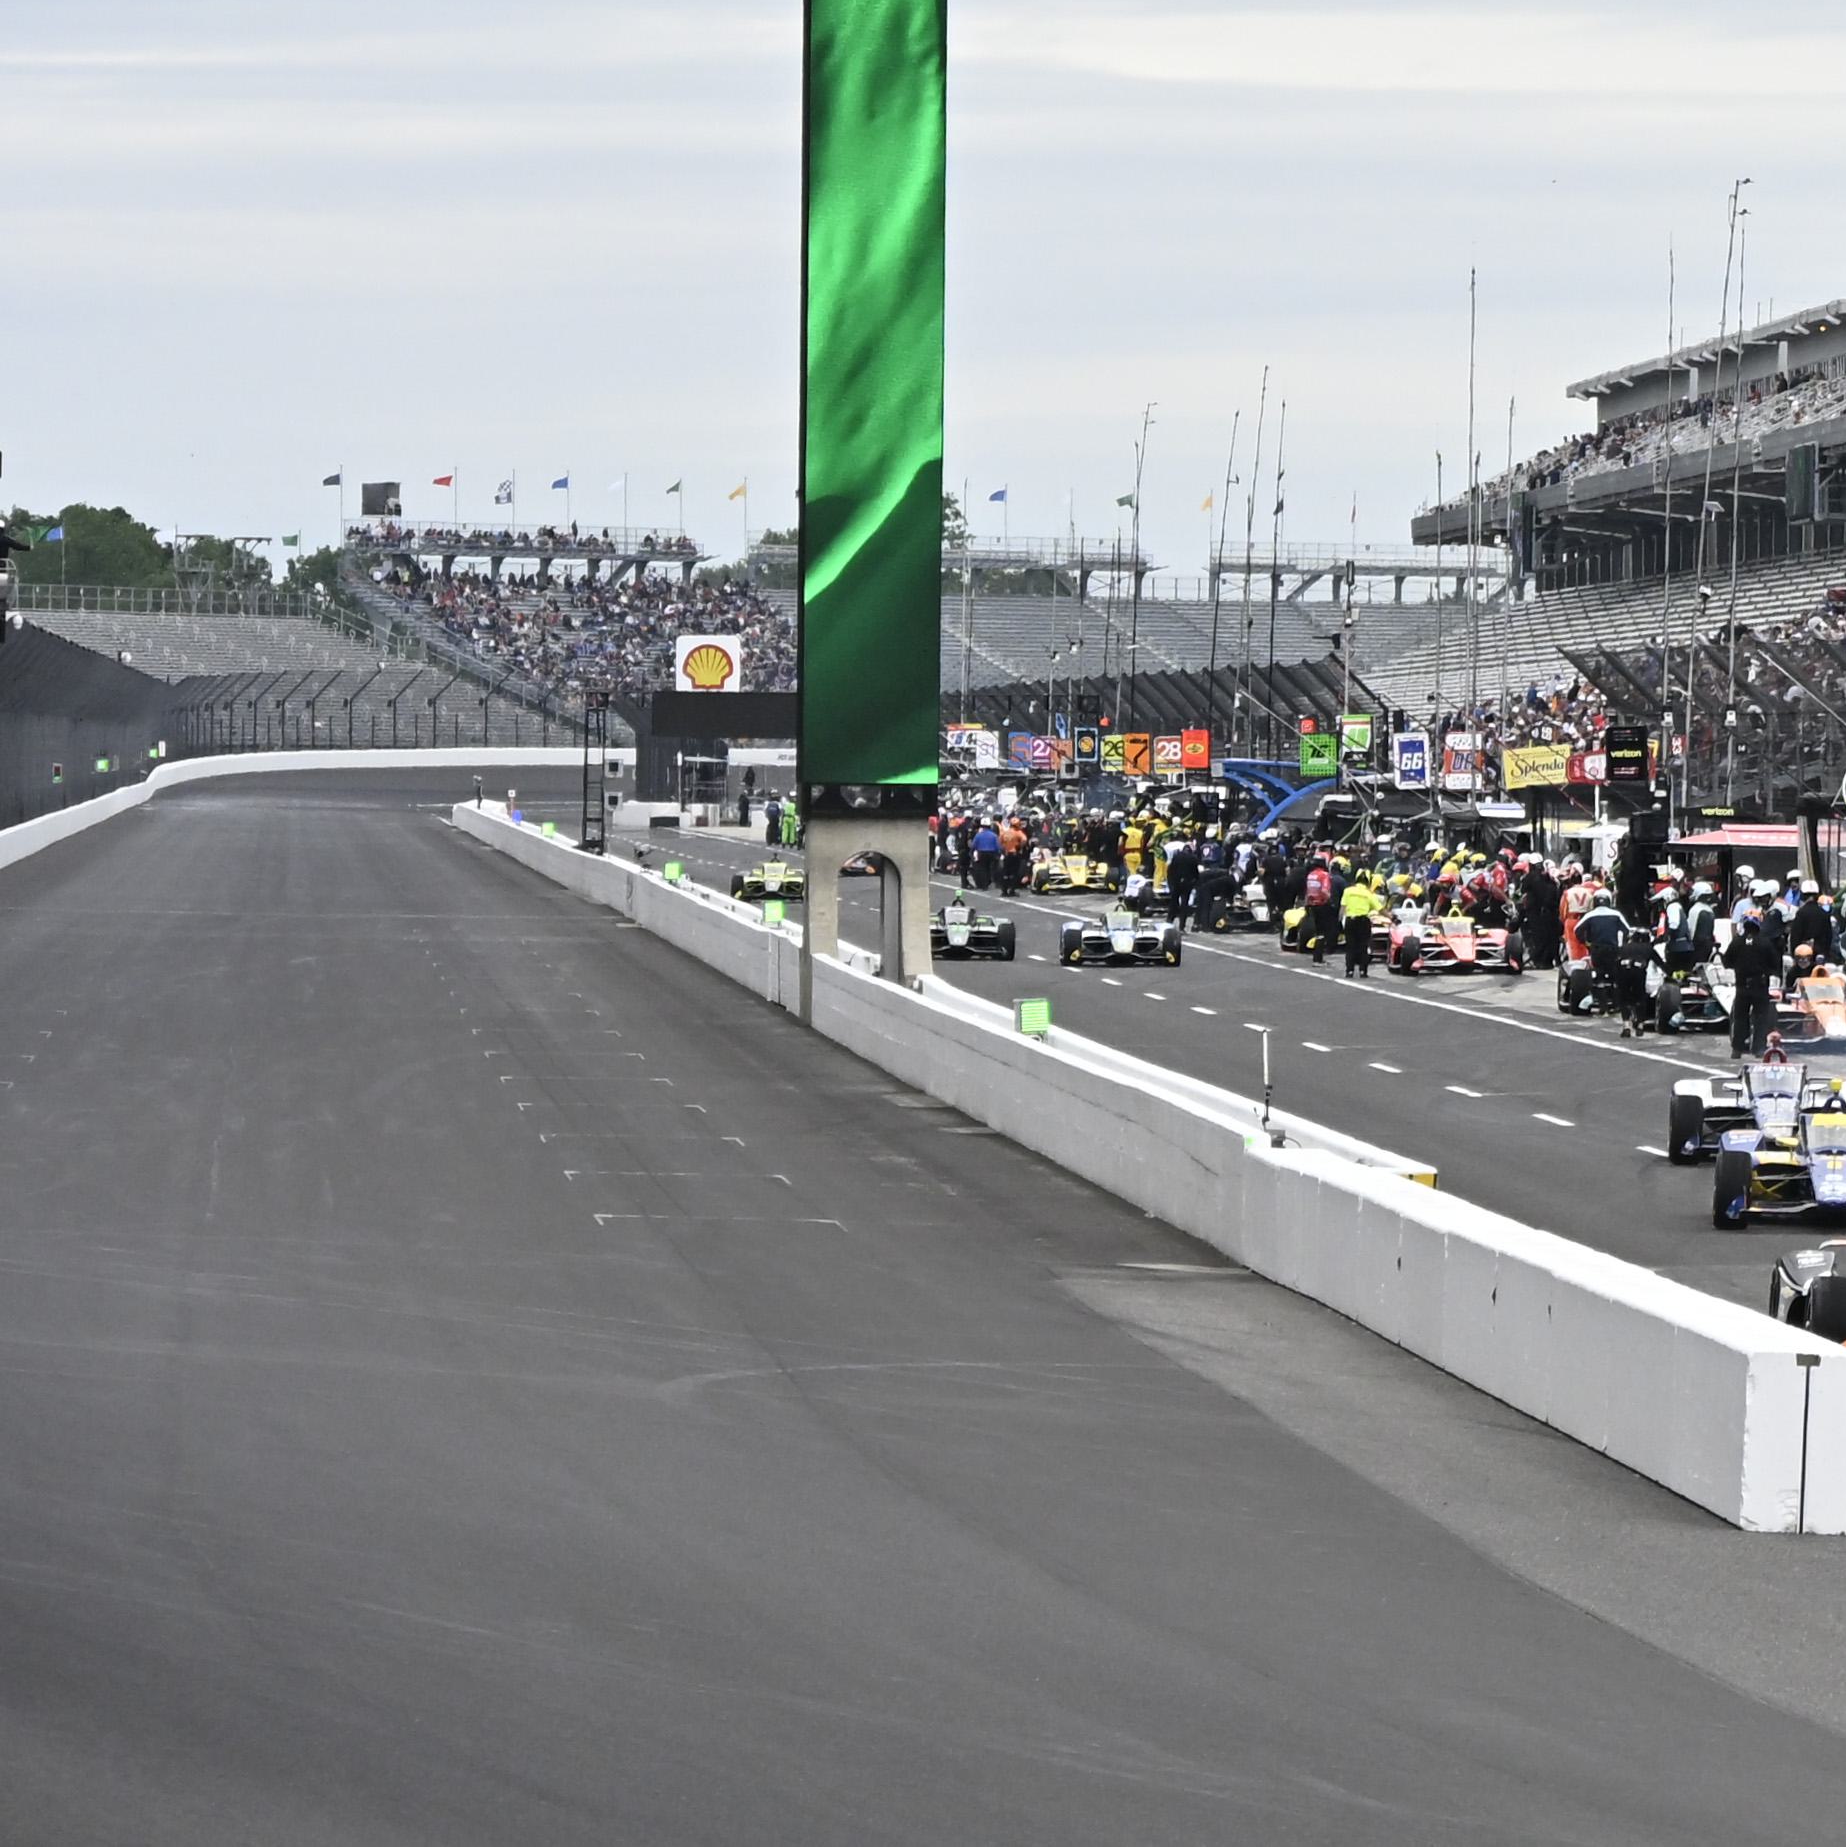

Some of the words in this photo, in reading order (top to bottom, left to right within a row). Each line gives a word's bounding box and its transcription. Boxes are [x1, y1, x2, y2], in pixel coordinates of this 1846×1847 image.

[1104, 740, 1124, 757] 26
[1157, 741, 1181, 760] 28
[1610, 749, 1641, 758] verizon
[1401, 753, 1423, 770] 66
[1510, 758, 1564, 779] Splenda
[1701, 807, 1735, 816] verizon
